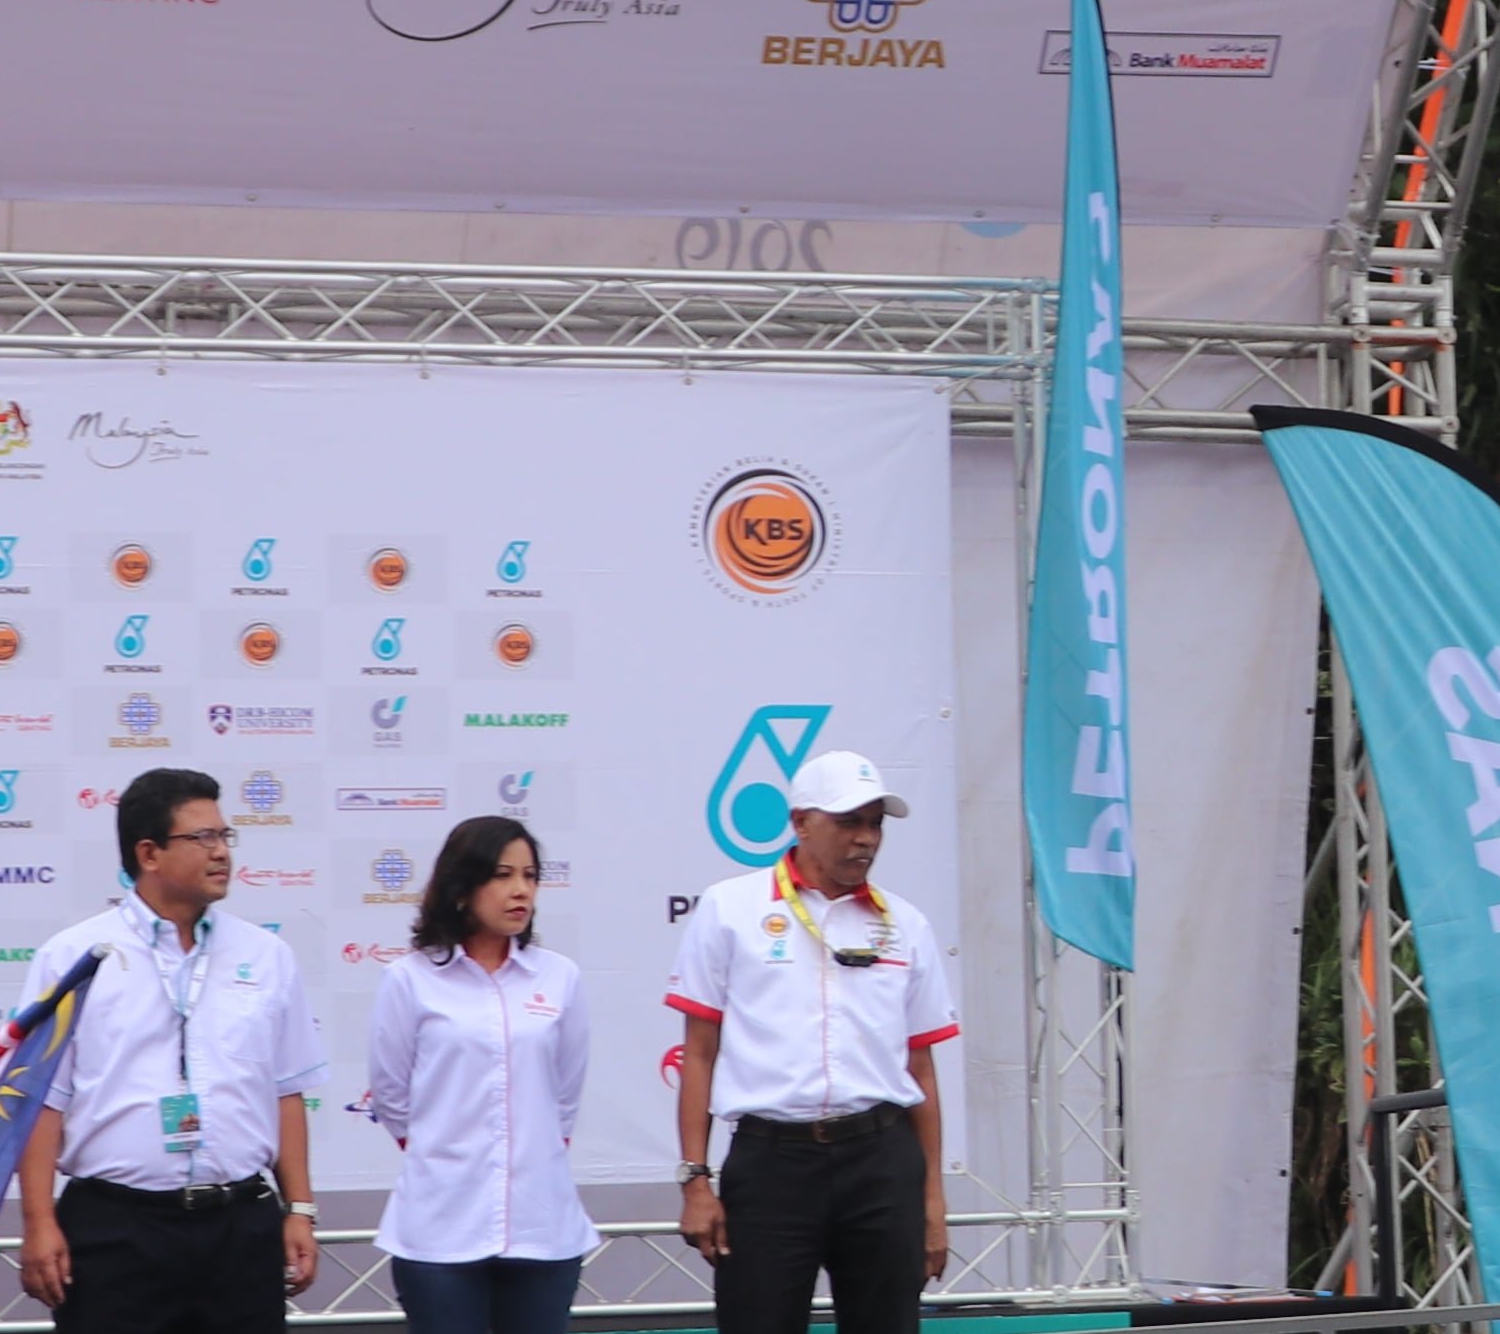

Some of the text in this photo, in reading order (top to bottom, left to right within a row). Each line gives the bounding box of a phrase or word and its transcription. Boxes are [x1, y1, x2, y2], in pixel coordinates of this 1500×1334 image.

[761, 35, 947, 70] BERJAYA
[743, 518, 804, 546] KBS
[463, 712, 570, 728] MALAKOFF
